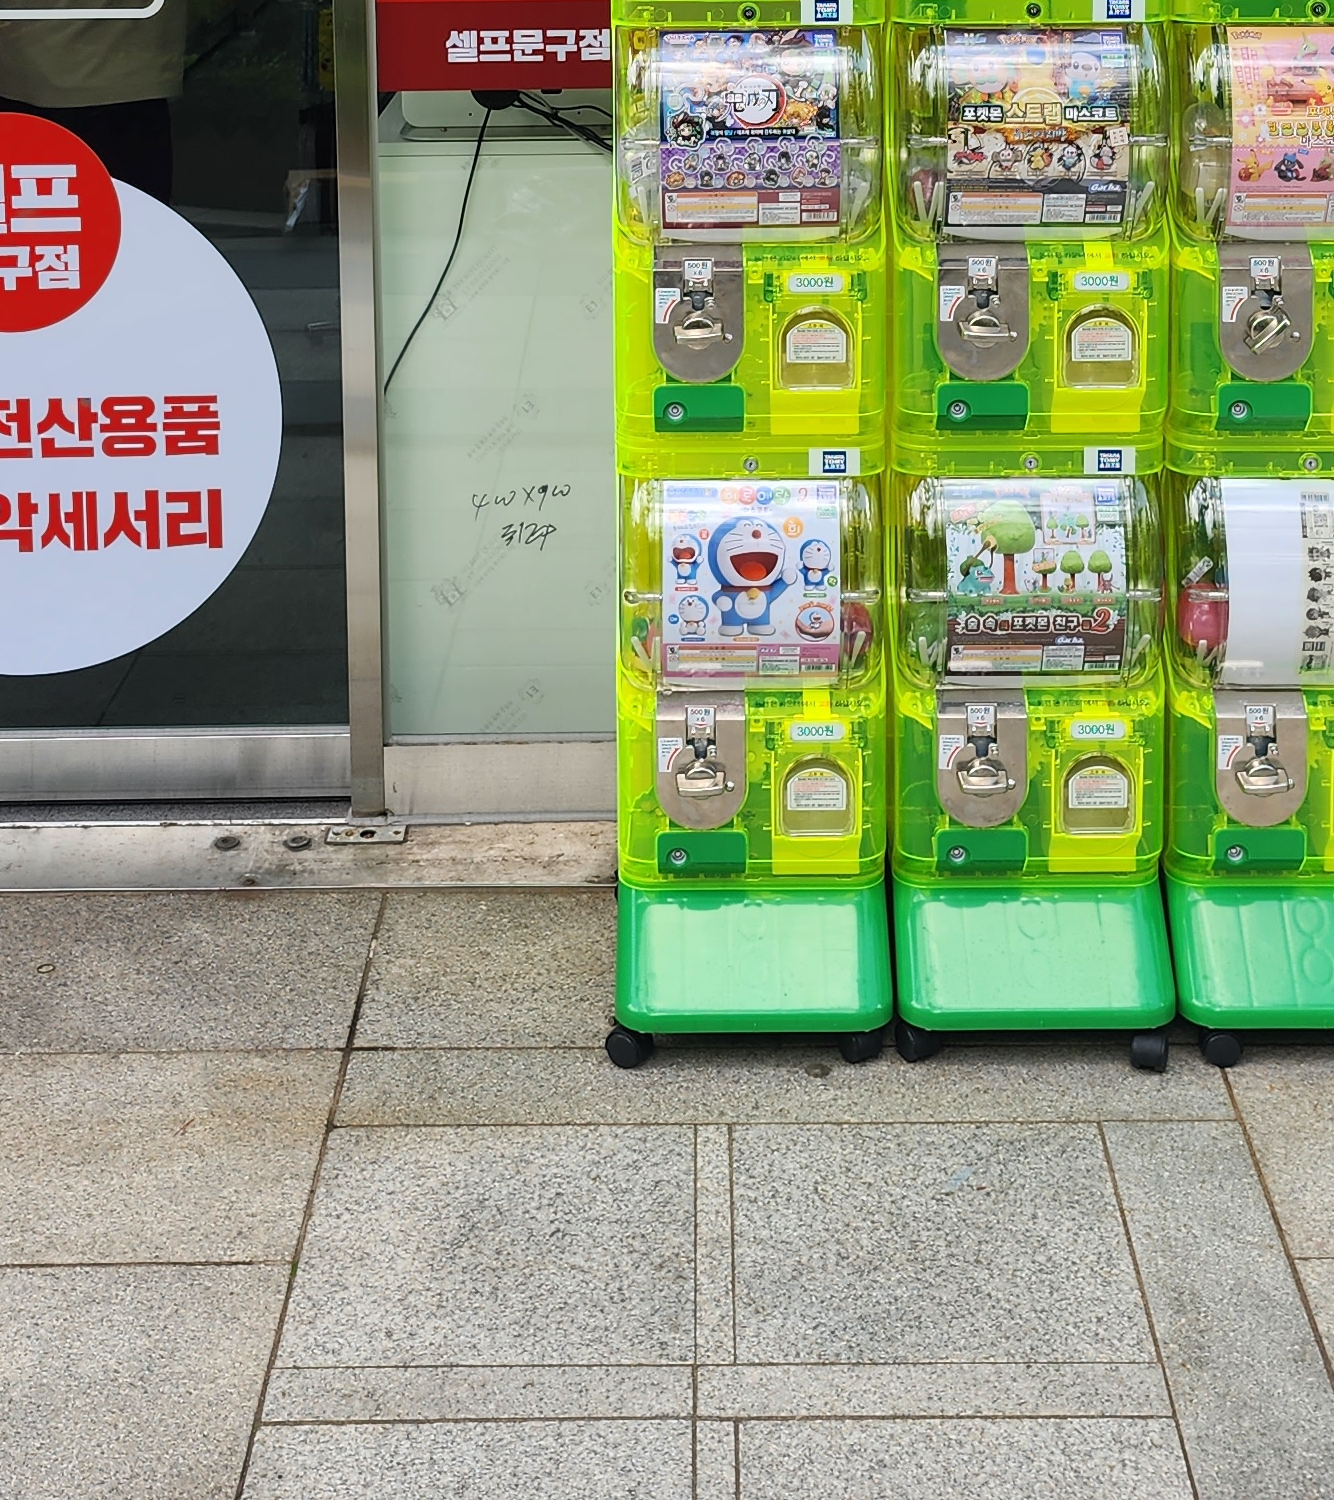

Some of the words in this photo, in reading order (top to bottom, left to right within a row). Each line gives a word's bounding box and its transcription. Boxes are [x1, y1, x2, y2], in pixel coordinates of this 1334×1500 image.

[446, 29, 610, 63] 셀프문구점
[1006, 103, 1062, 125] 스트랩
[1066, 106, 1118, 121] 마스코트
[796, 277, 833, 287] 3000원
[1081, 276, 1118, 286] 3000원
[797, 725, 834, 736] 3000원
[1078, 723, 1115, 735] 3000원
